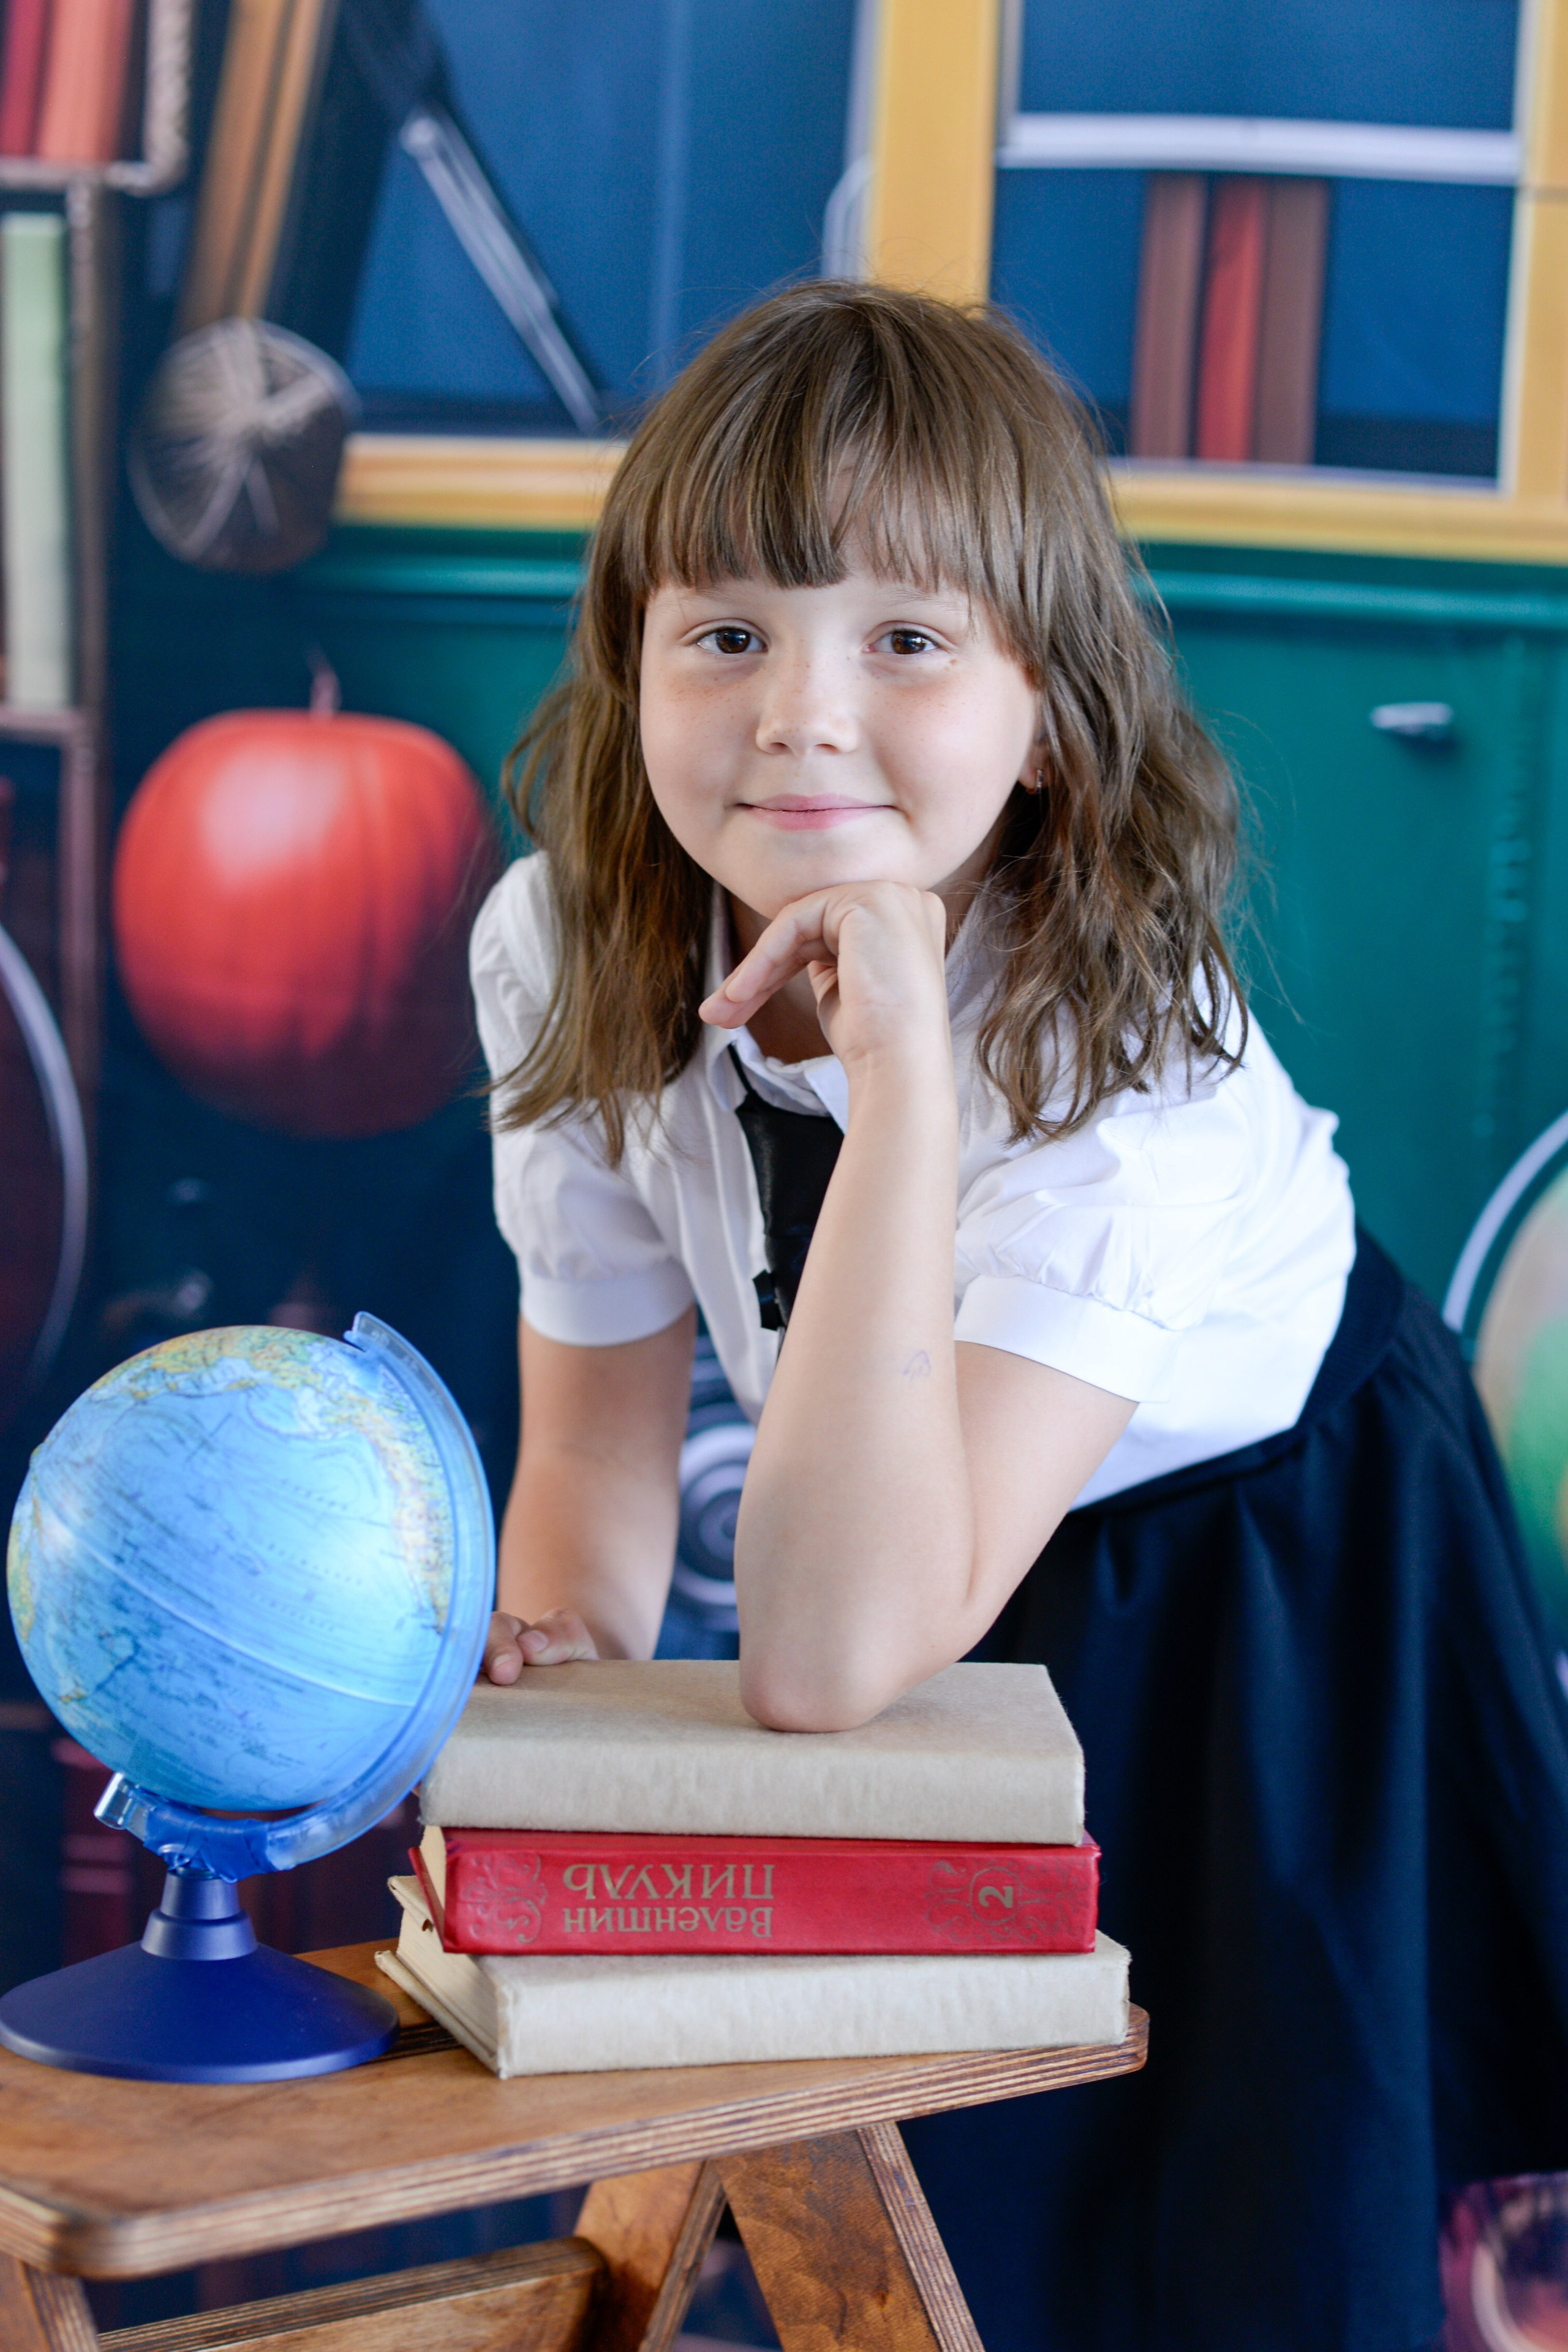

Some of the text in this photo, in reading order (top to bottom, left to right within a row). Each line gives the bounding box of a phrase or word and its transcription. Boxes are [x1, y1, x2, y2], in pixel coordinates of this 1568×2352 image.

[562, 1863, 775, 1900] ПИКУЛЬ
[978, 1885, 1014, 1909] 2
[562, 1906, 774, 1938] Валентин
